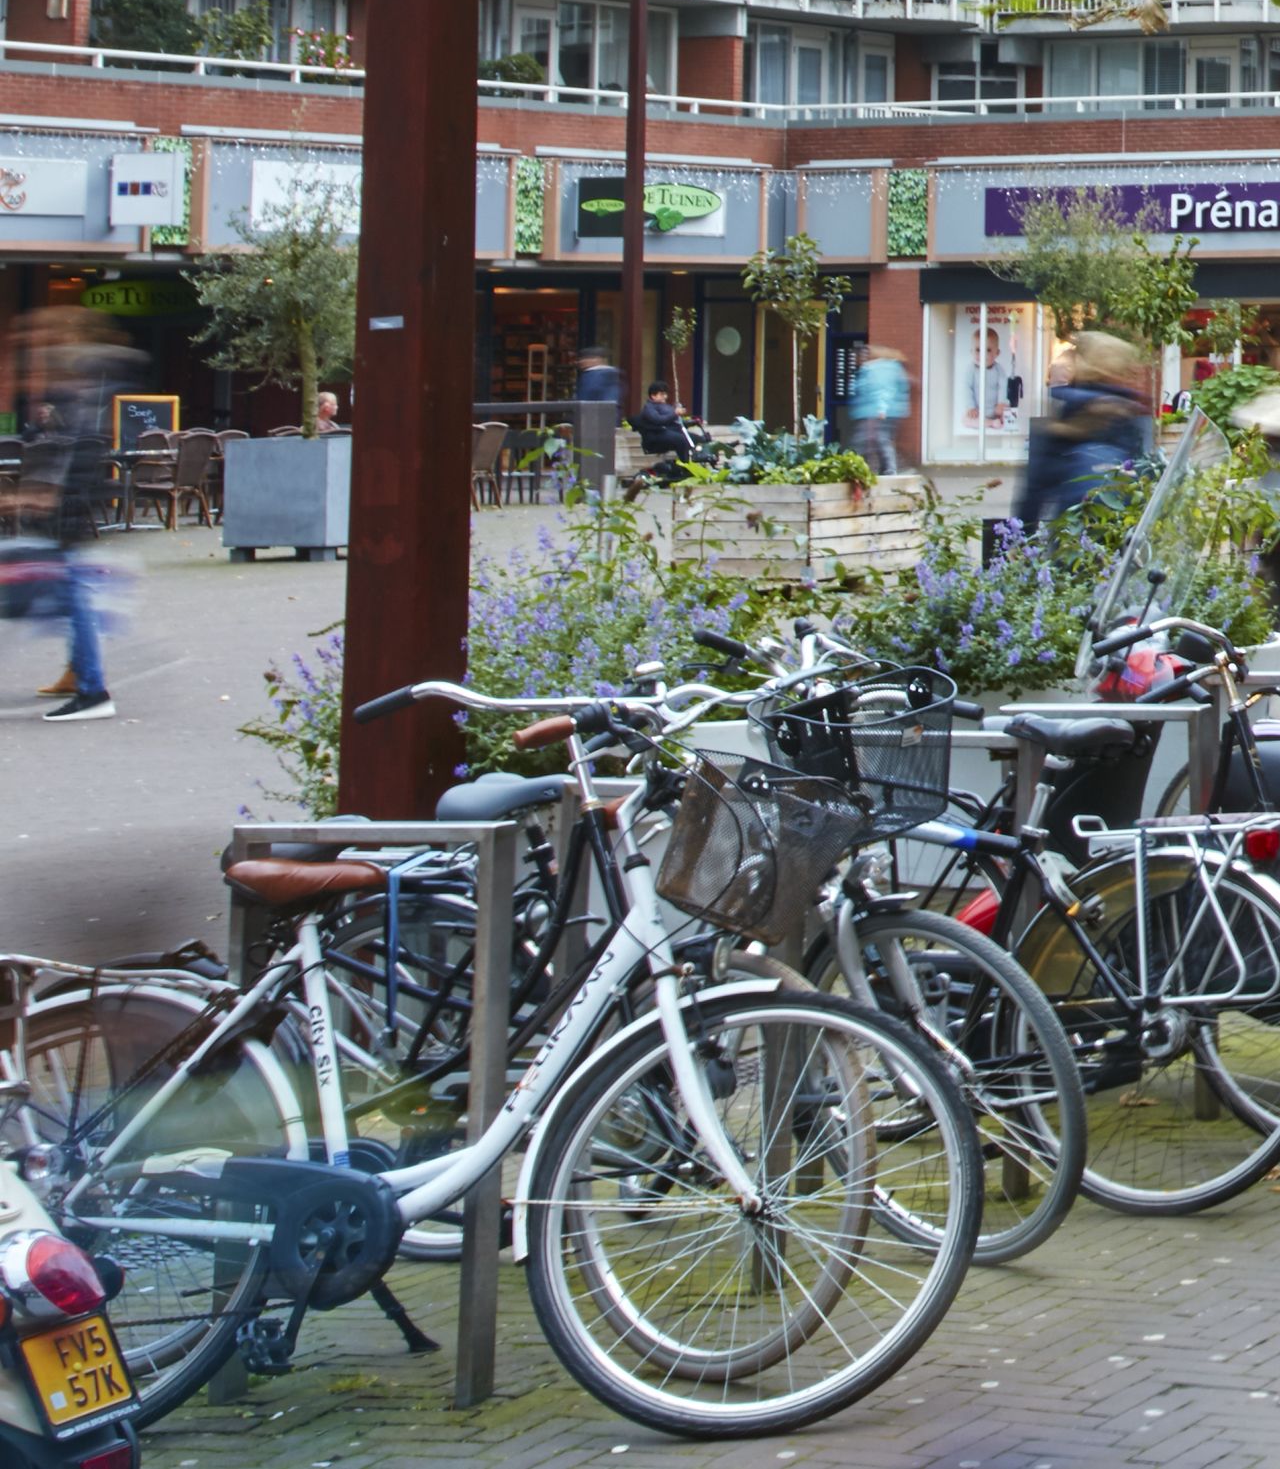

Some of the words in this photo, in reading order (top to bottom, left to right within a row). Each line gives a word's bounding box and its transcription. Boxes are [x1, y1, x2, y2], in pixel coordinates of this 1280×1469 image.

[657, 188, 714, 208] TUINEN
[91, 291, 116, 305] DE
[54, 1324, 107, 1370] FV5
[66, 1362, 124, 1408] 57K
